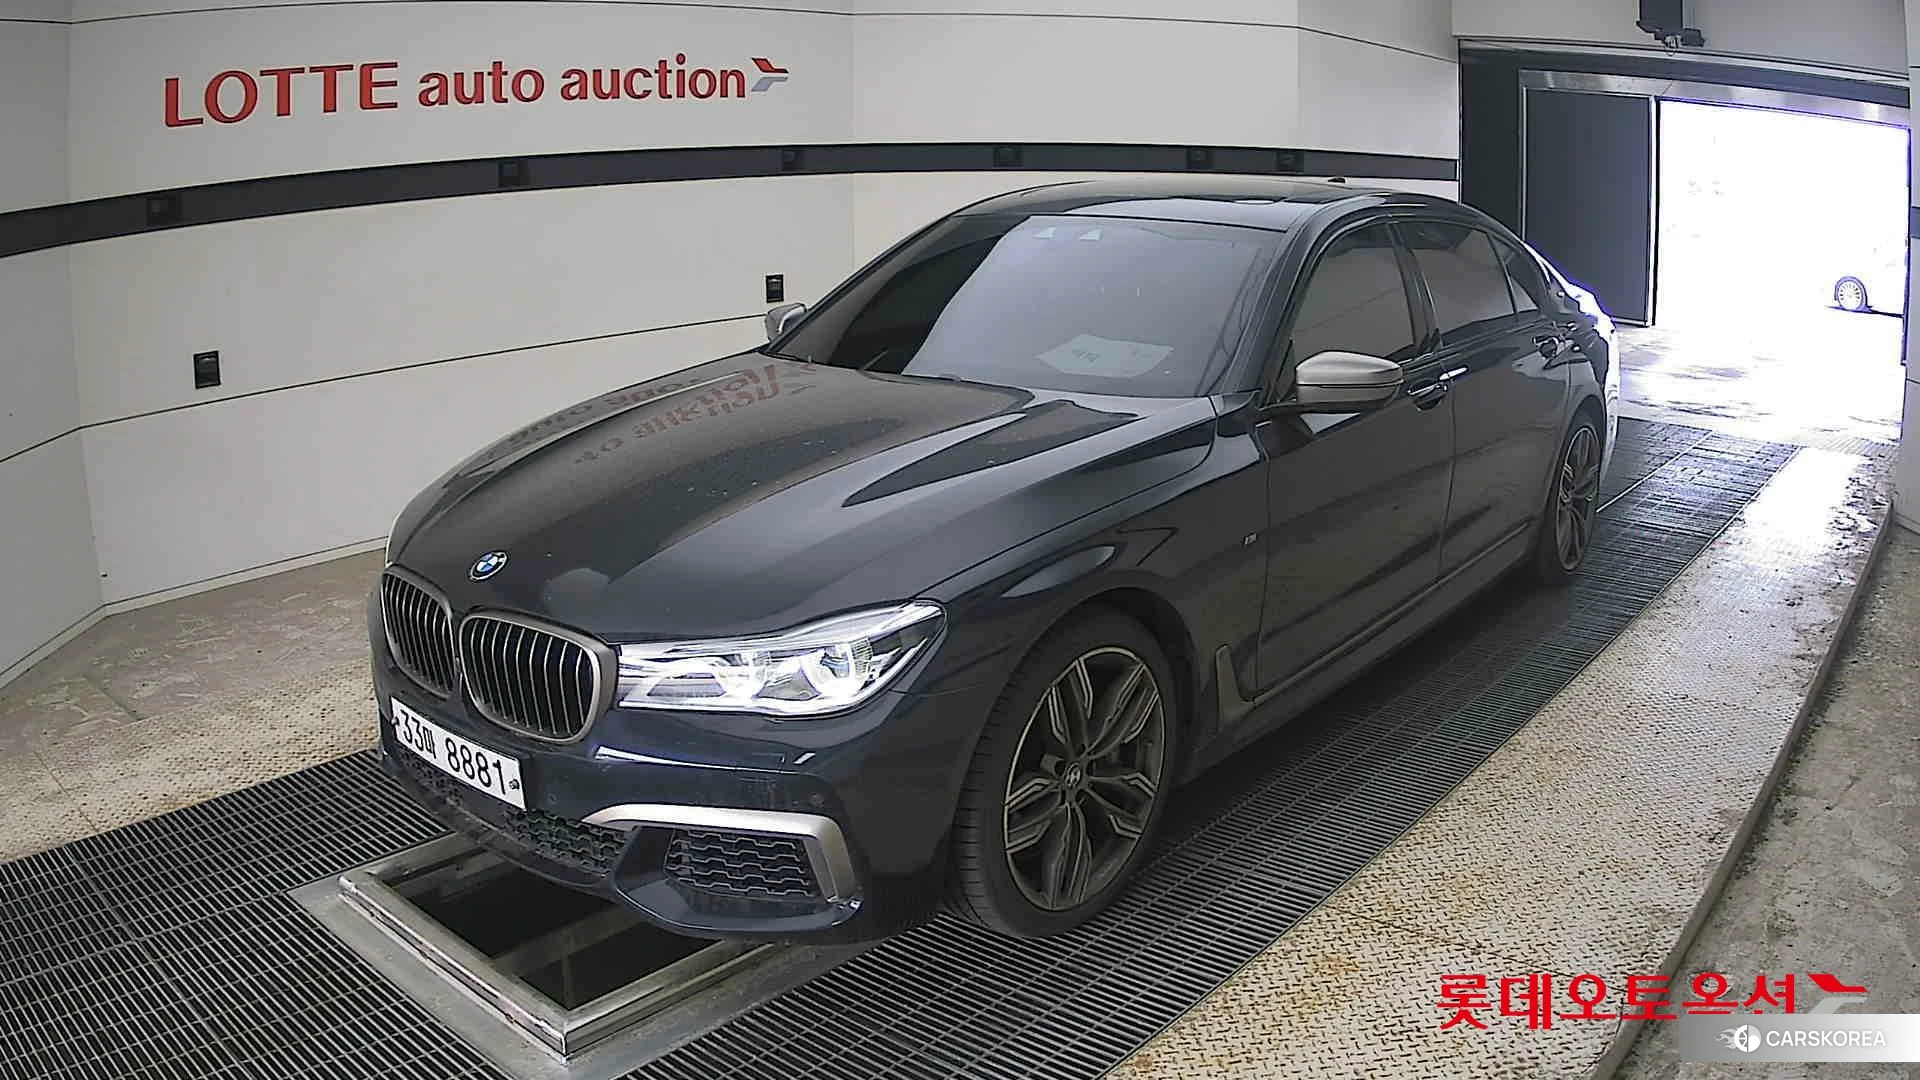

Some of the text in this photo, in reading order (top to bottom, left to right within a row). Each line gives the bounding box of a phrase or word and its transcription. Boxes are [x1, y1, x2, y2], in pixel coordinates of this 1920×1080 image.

[164, 52, 747, 128] LOTTE auto auction
[444, 736, 506, 796] 8881
